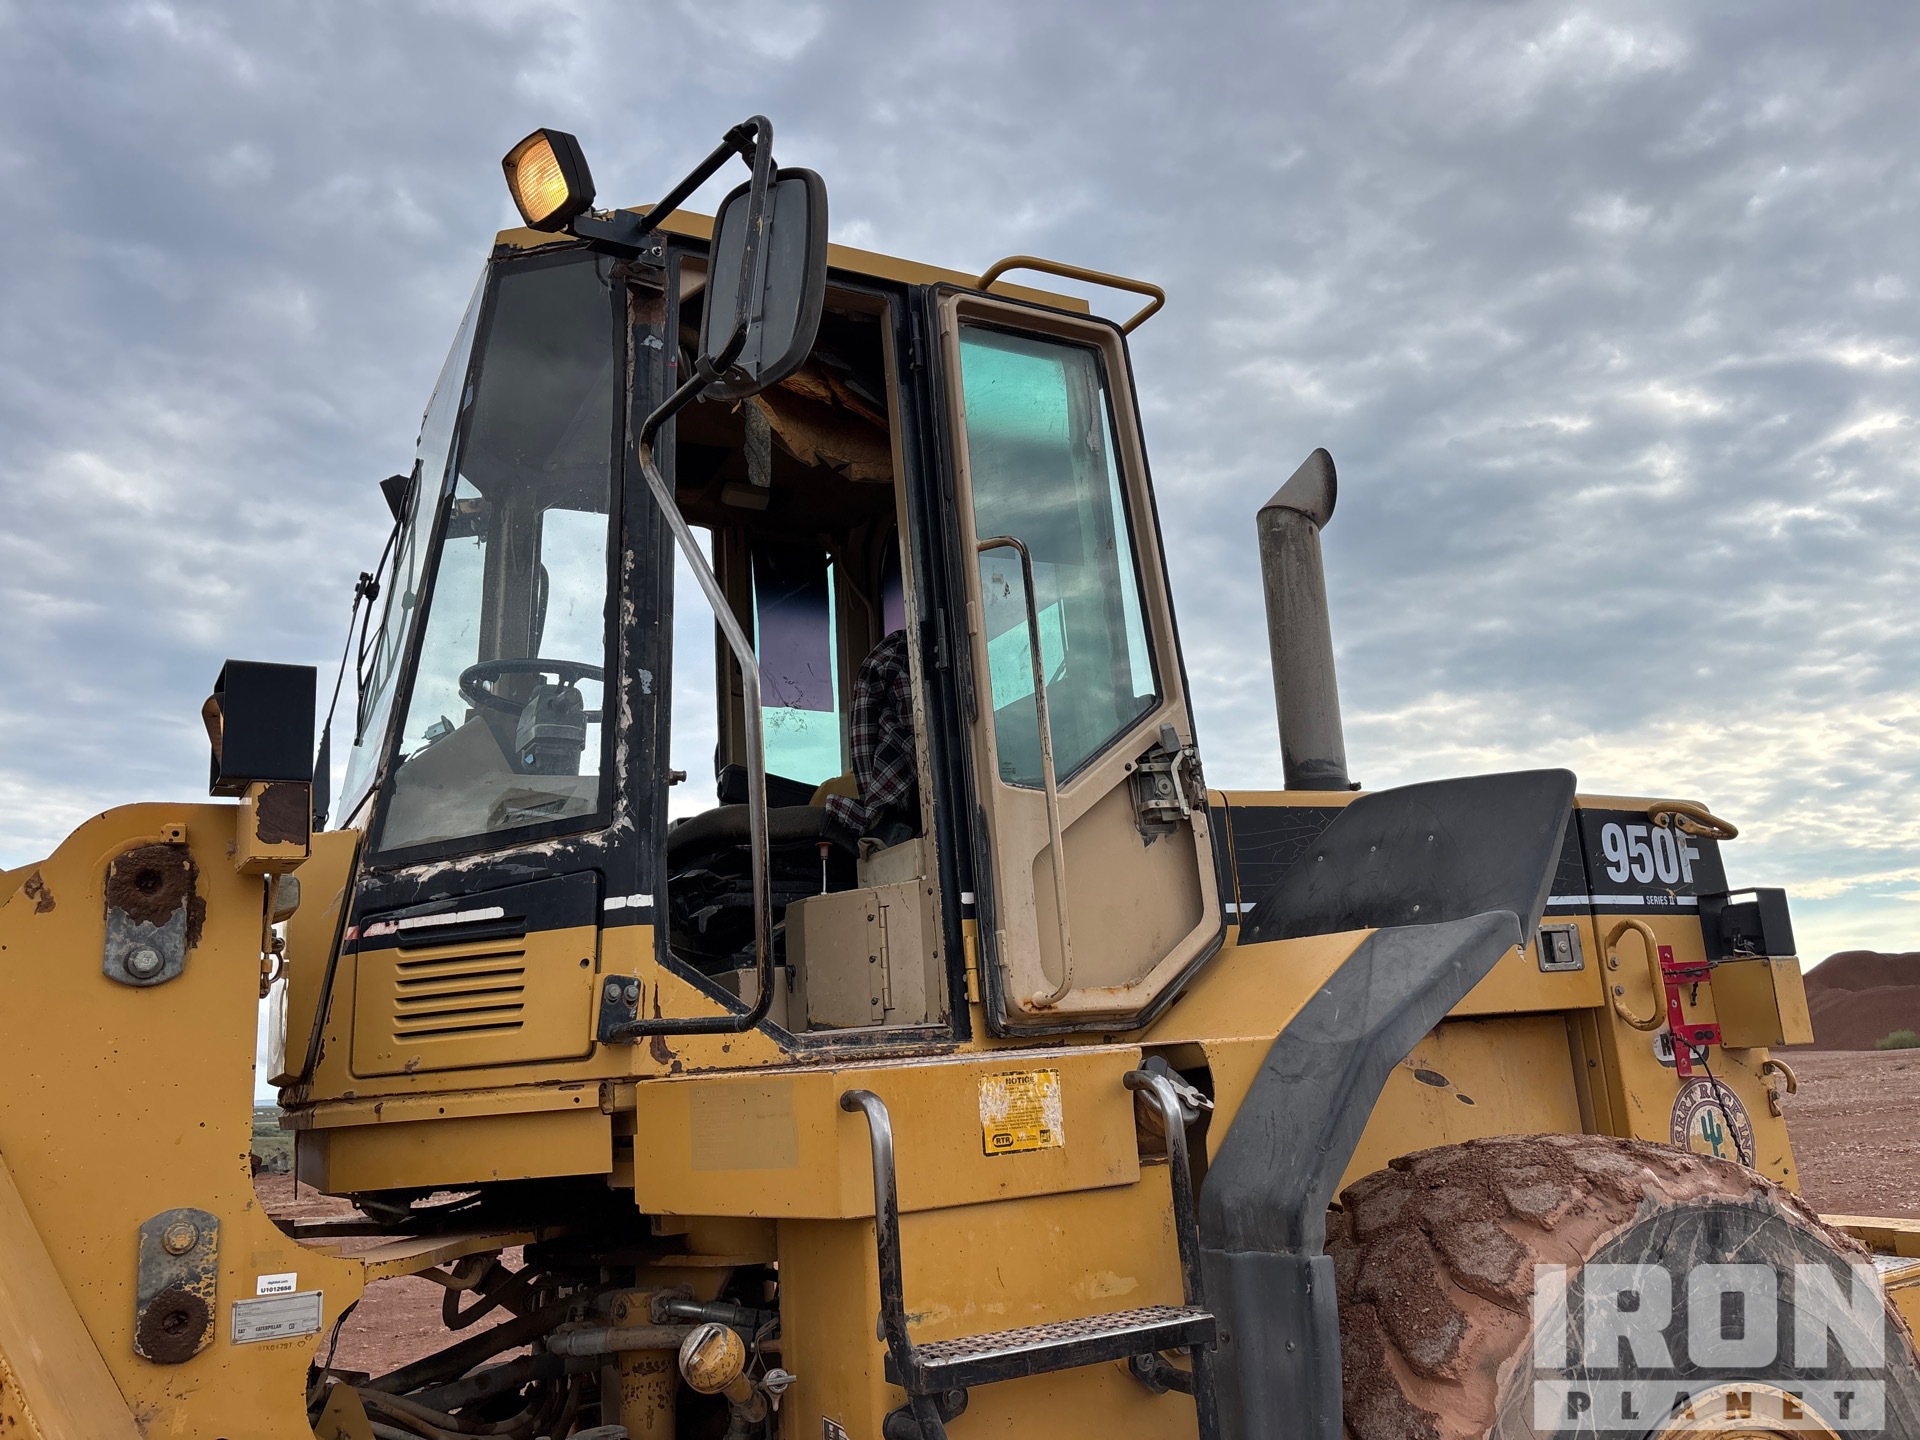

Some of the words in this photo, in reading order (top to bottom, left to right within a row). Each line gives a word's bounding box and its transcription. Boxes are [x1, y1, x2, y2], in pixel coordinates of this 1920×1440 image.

[1601, 822, 1700, 884] 950F
[1646, 895, 1668, 905] SERIES
[1698, 1083, 1741, 1117] ROCK
[995, 1136, 1011, 1144] RTR
